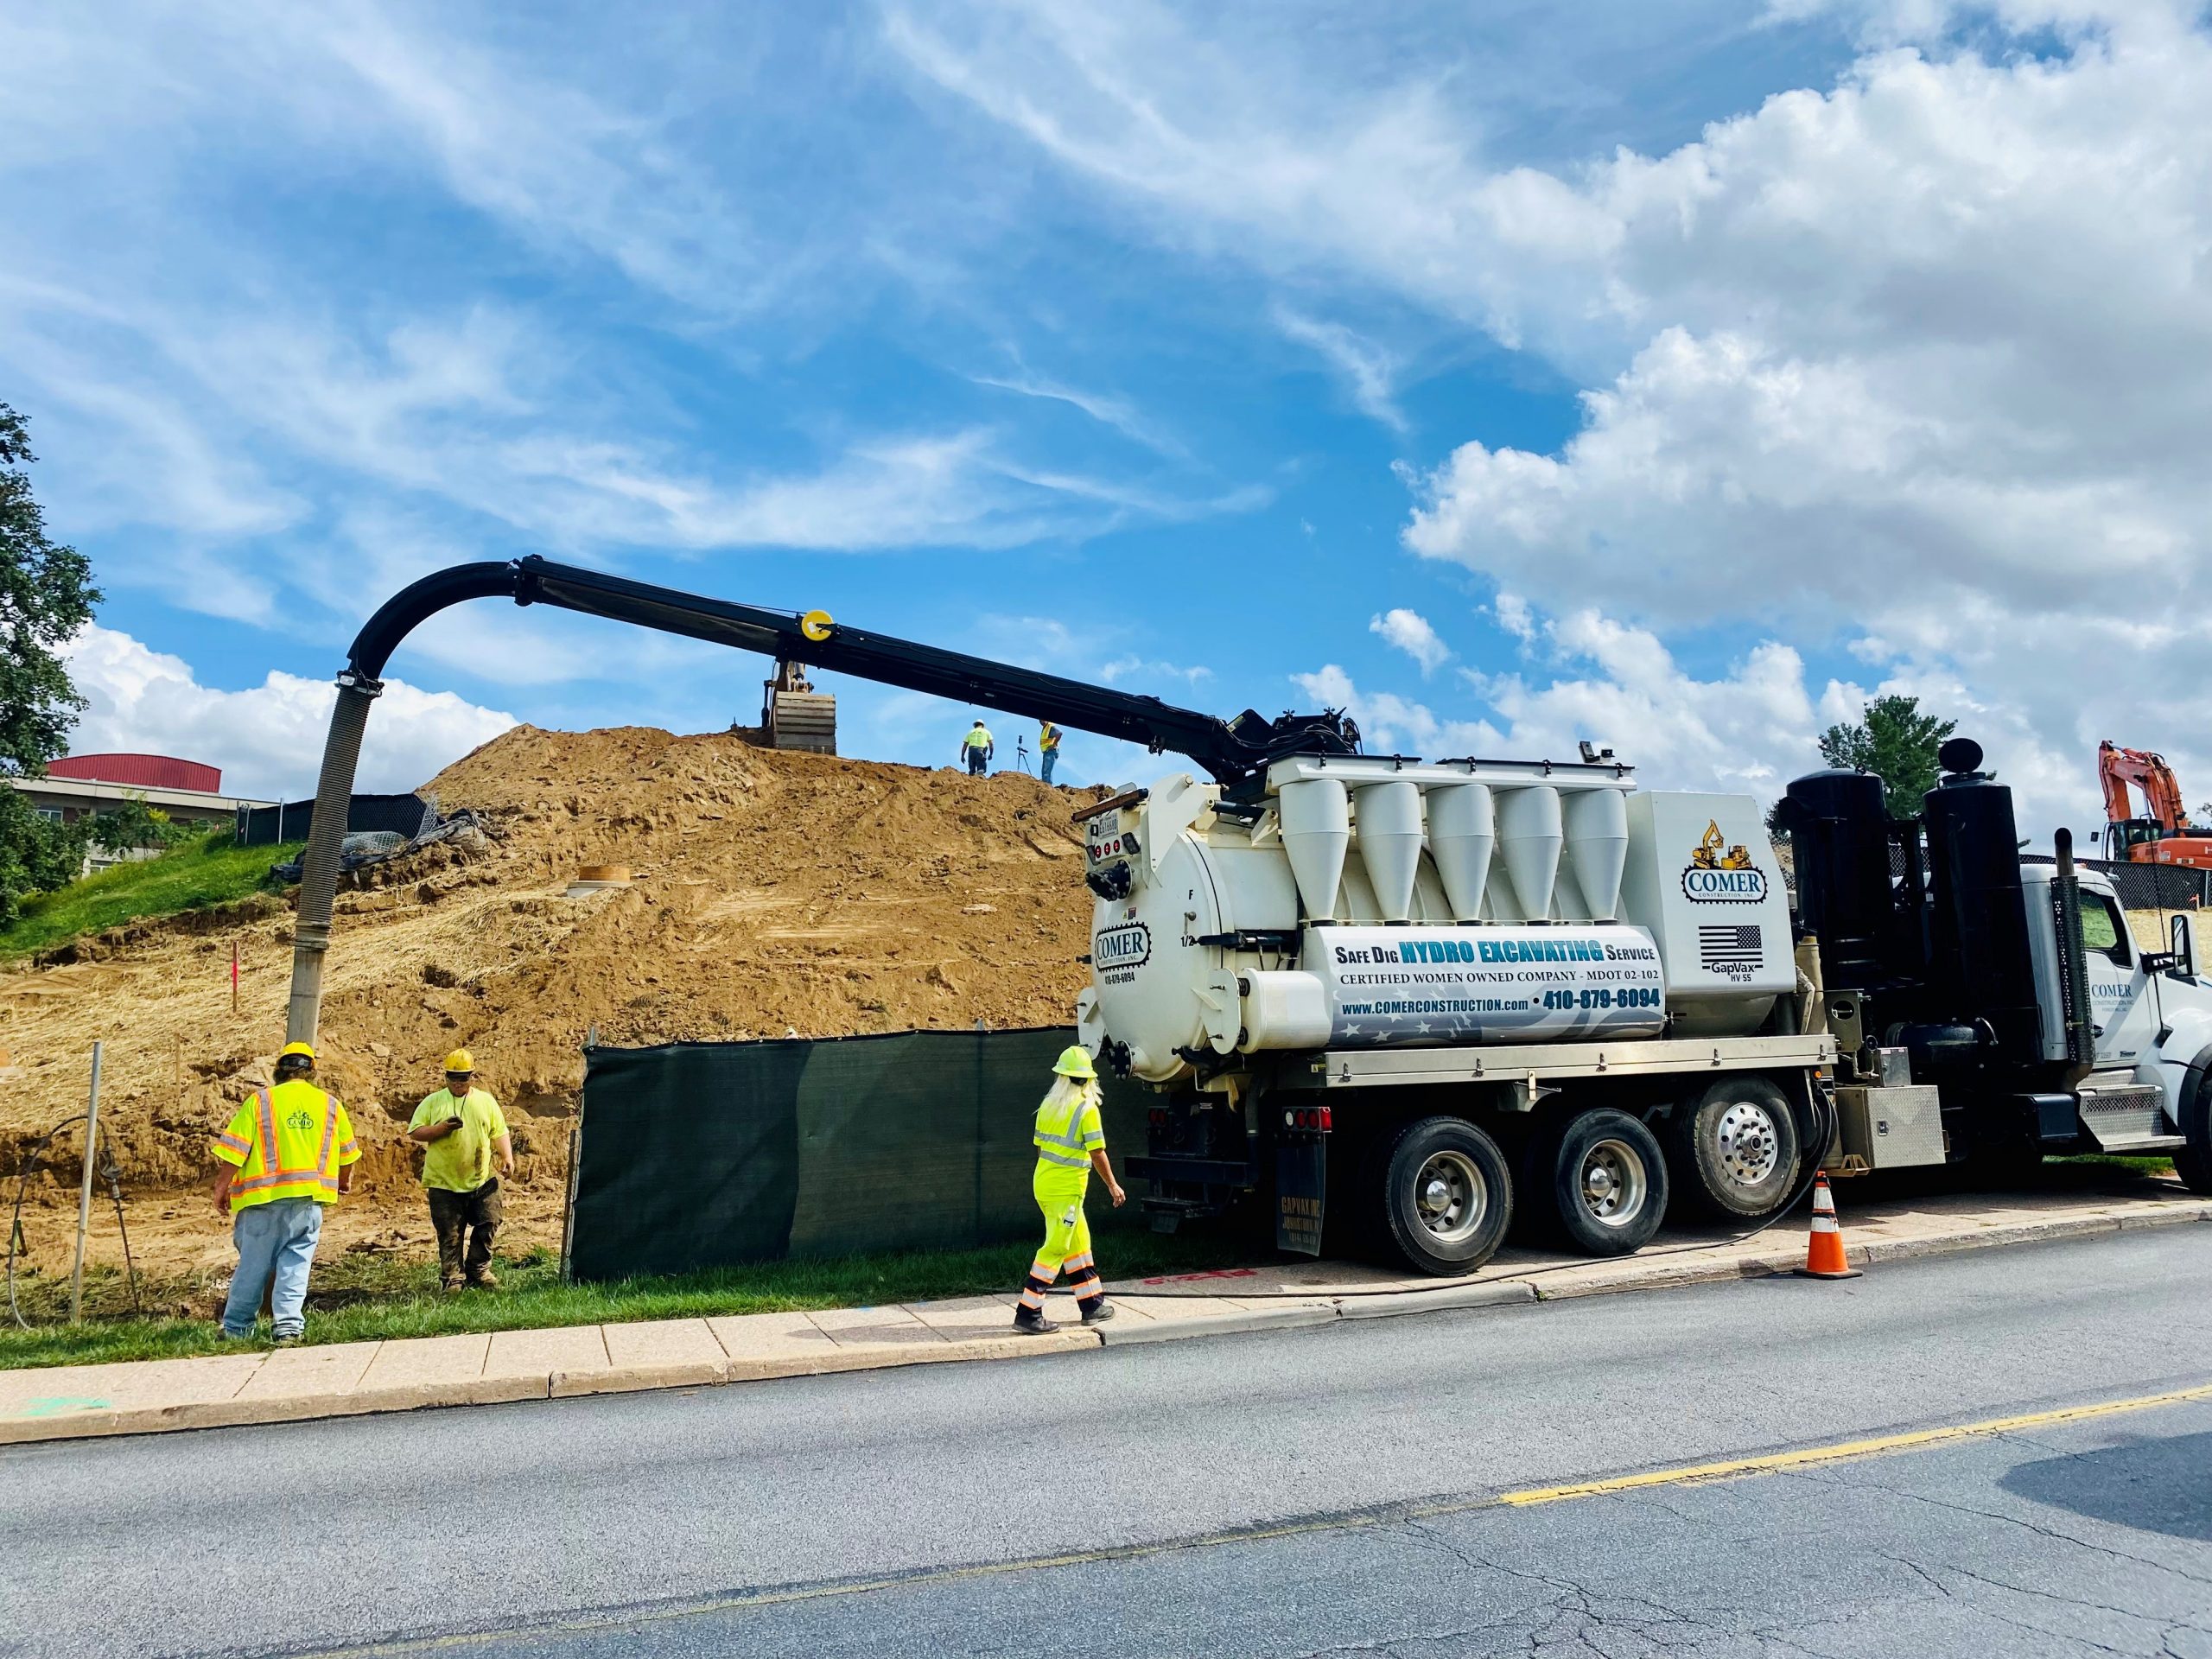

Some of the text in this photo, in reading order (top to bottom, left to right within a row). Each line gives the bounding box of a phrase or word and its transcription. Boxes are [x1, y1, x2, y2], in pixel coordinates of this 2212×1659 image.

[1688, 873, 1762, 892] COMER
[1188, 889, 1193, 899] F
[1096, 932, 1144, 960] COMER
[1180, 935, 1195, 947] 1/2
[1398, 941, 1475, 963] HYDRO
[1477, 940, 1605, 963] EXCAVATING
[1340, 974, 1410, 985] CERTIFIED
[1413, 973, 1463, 983] WOMEN
[1466, 972, 1513, 982] OWNED
[1517, 971, 1576, 982] COMPANY
[1586, 970, 1622, 980] MDOT
[1624, 969, 1659, 980] 02-102
[1712, 962, 1755, 976] GapVax
[1543, 988, 1660, 1009] 410-879-6094
[2091, 984, 2133, 997] COMER
[1281, 1197, 1309, 1215] GAPVAX
